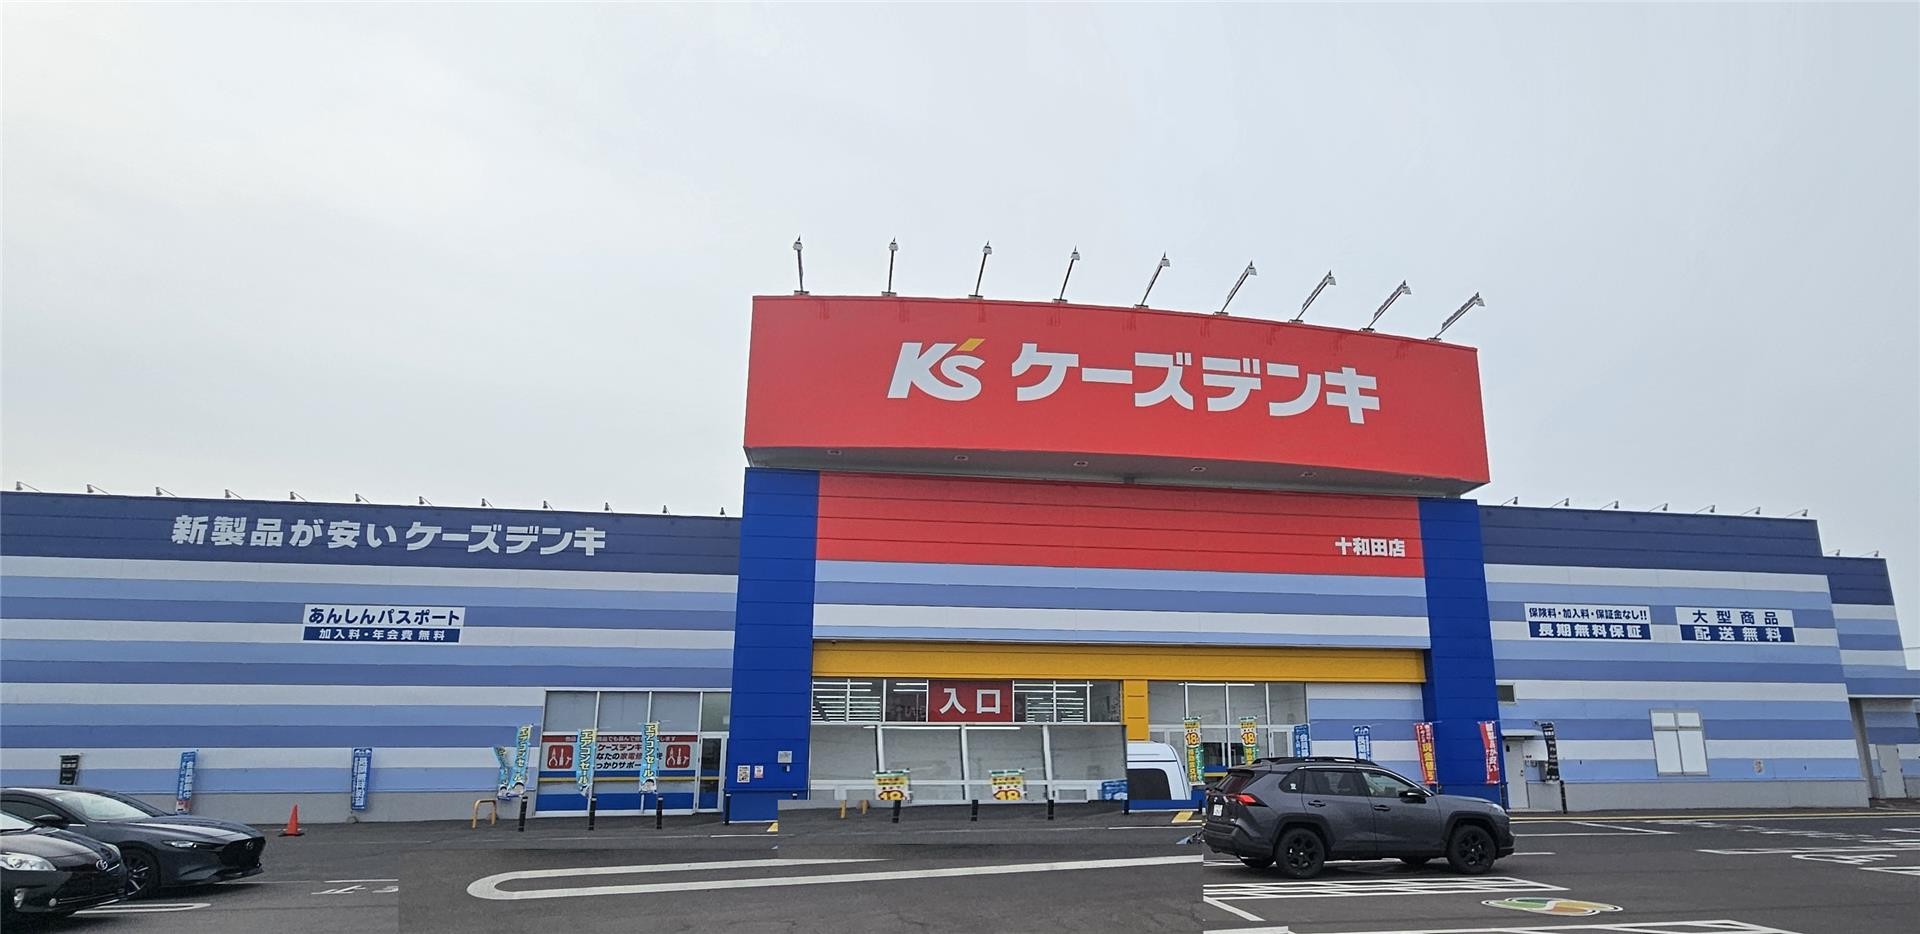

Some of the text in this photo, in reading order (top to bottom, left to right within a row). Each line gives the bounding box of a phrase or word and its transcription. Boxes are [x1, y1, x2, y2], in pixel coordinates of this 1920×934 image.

[888, 338, 1380, 425] K's ケーズデンキ
[1335, 536, 1406, 558] 十和田店
[308, 607, 461, 627] あんしんパスポート
[1692, 610, 1780, 625] 大型商品
[1537, 623, 1642, 640] 長期無料保証
[1694, 626, 1782, 642] 配送無料
[939, 687, 1001, 715] 入口
[578, 730, 594, 785] エアコンセール
[642, 724, 657, 777] エアコンセール
